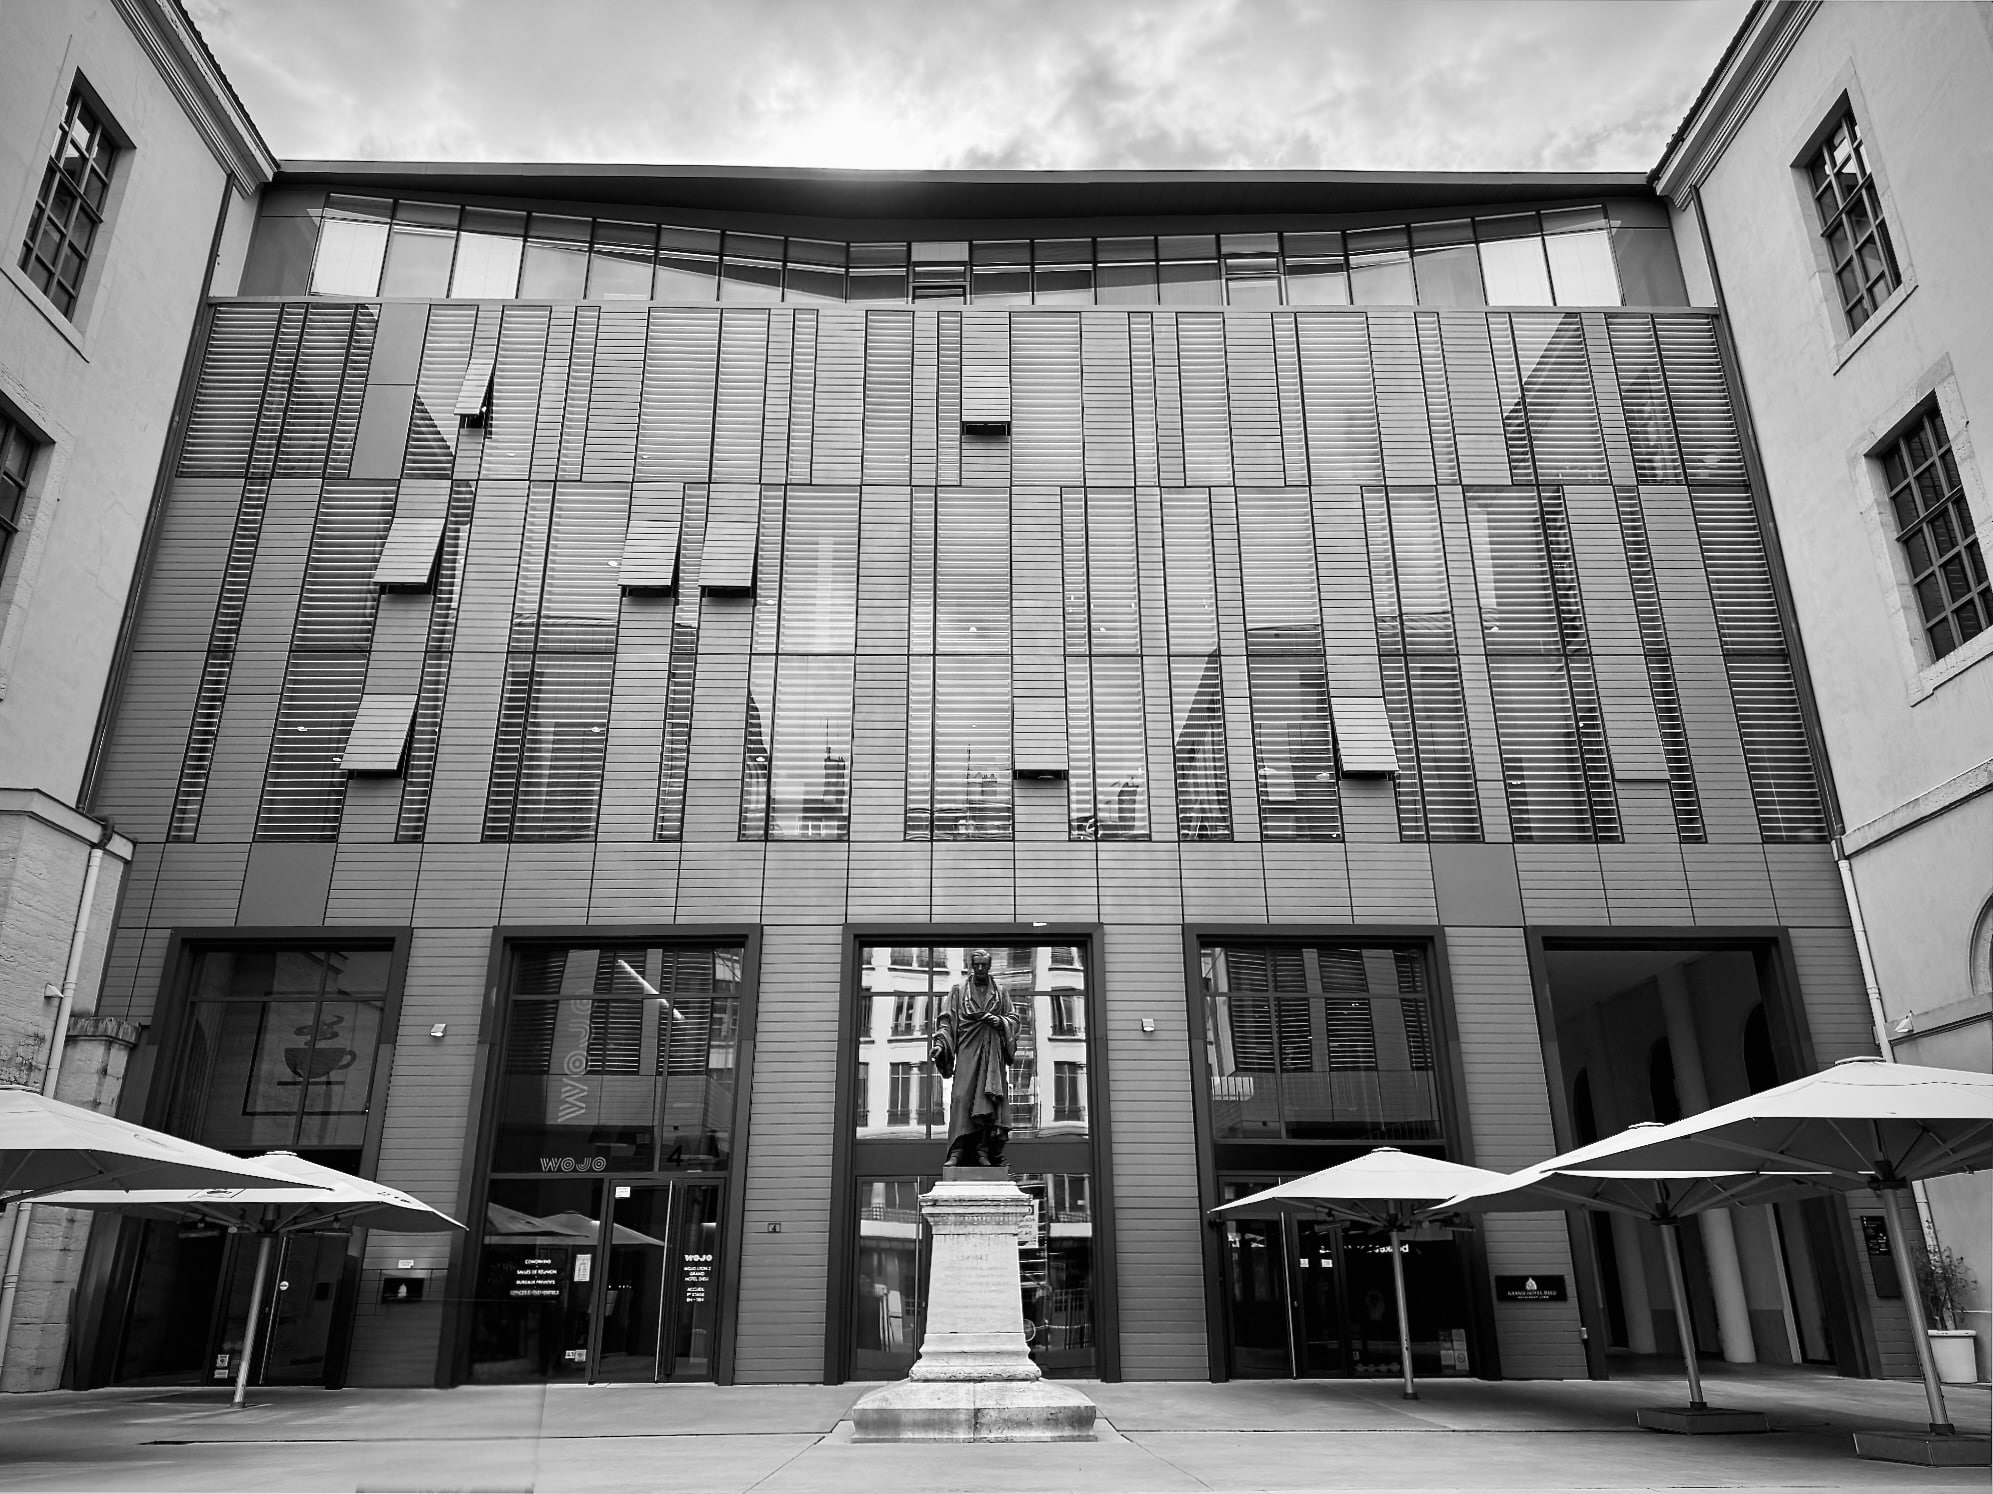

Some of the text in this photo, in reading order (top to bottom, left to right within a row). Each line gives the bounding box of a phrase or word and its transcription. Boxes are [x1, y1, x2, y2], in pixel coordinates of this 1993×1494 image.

[667, 1145, 684, 1167] 4
[540, 1157, 606, 1172] WOJO
[684, 1254, 713, 1262] WOJO
